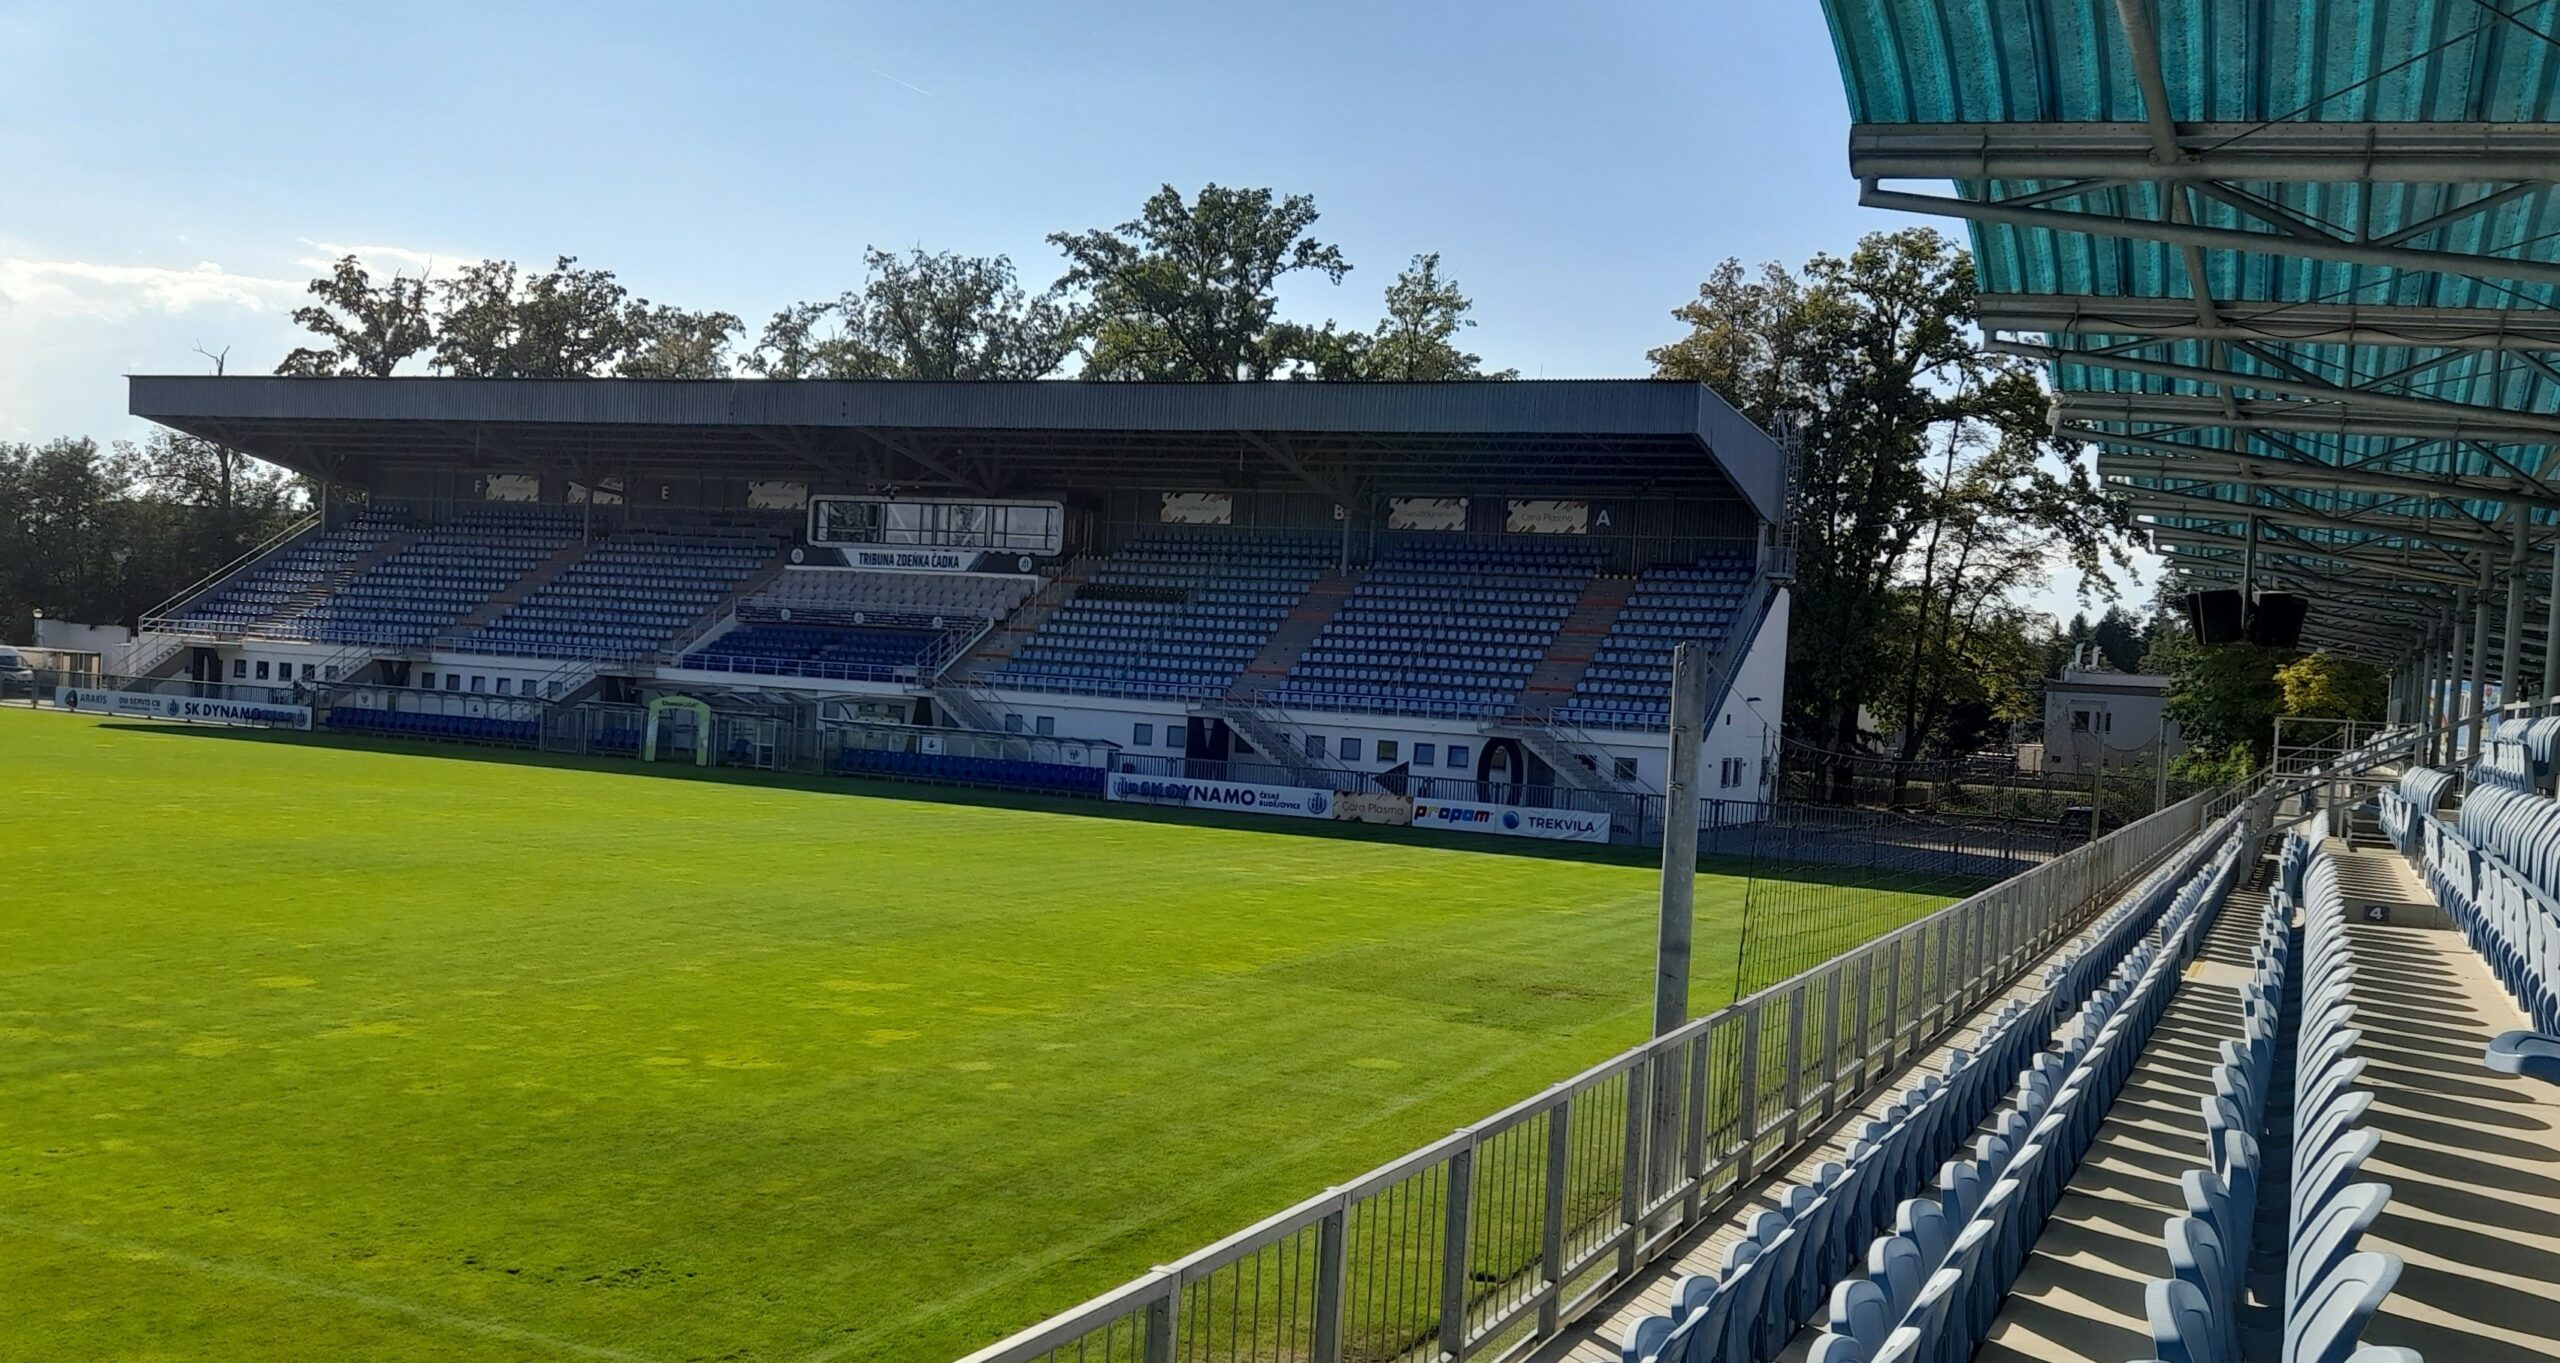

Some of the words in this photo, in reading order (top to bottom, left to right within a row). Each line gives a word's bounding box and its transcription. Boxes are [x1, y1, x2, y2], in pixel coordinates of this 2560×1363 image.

[474, 480, 481, 493] F
[661, 485, 670, 500] E
[1334, 504, 1345, 520] B
[1595, 509, 1612, 527] A
[858, 552, 895, 566] TRIBUNA
[896, 552, 930, 567] ZDEŇKA
[931, 552, 960, 569] ČADKA
[79, 693, 107, 705] ARAKIS
[184, 702, 200, 716] SK
[203, 703, 261, 721] DYNAMO
[1527, 816, 1596, 833] TREKVILA
[2369, 907, 2384, 920] 4
